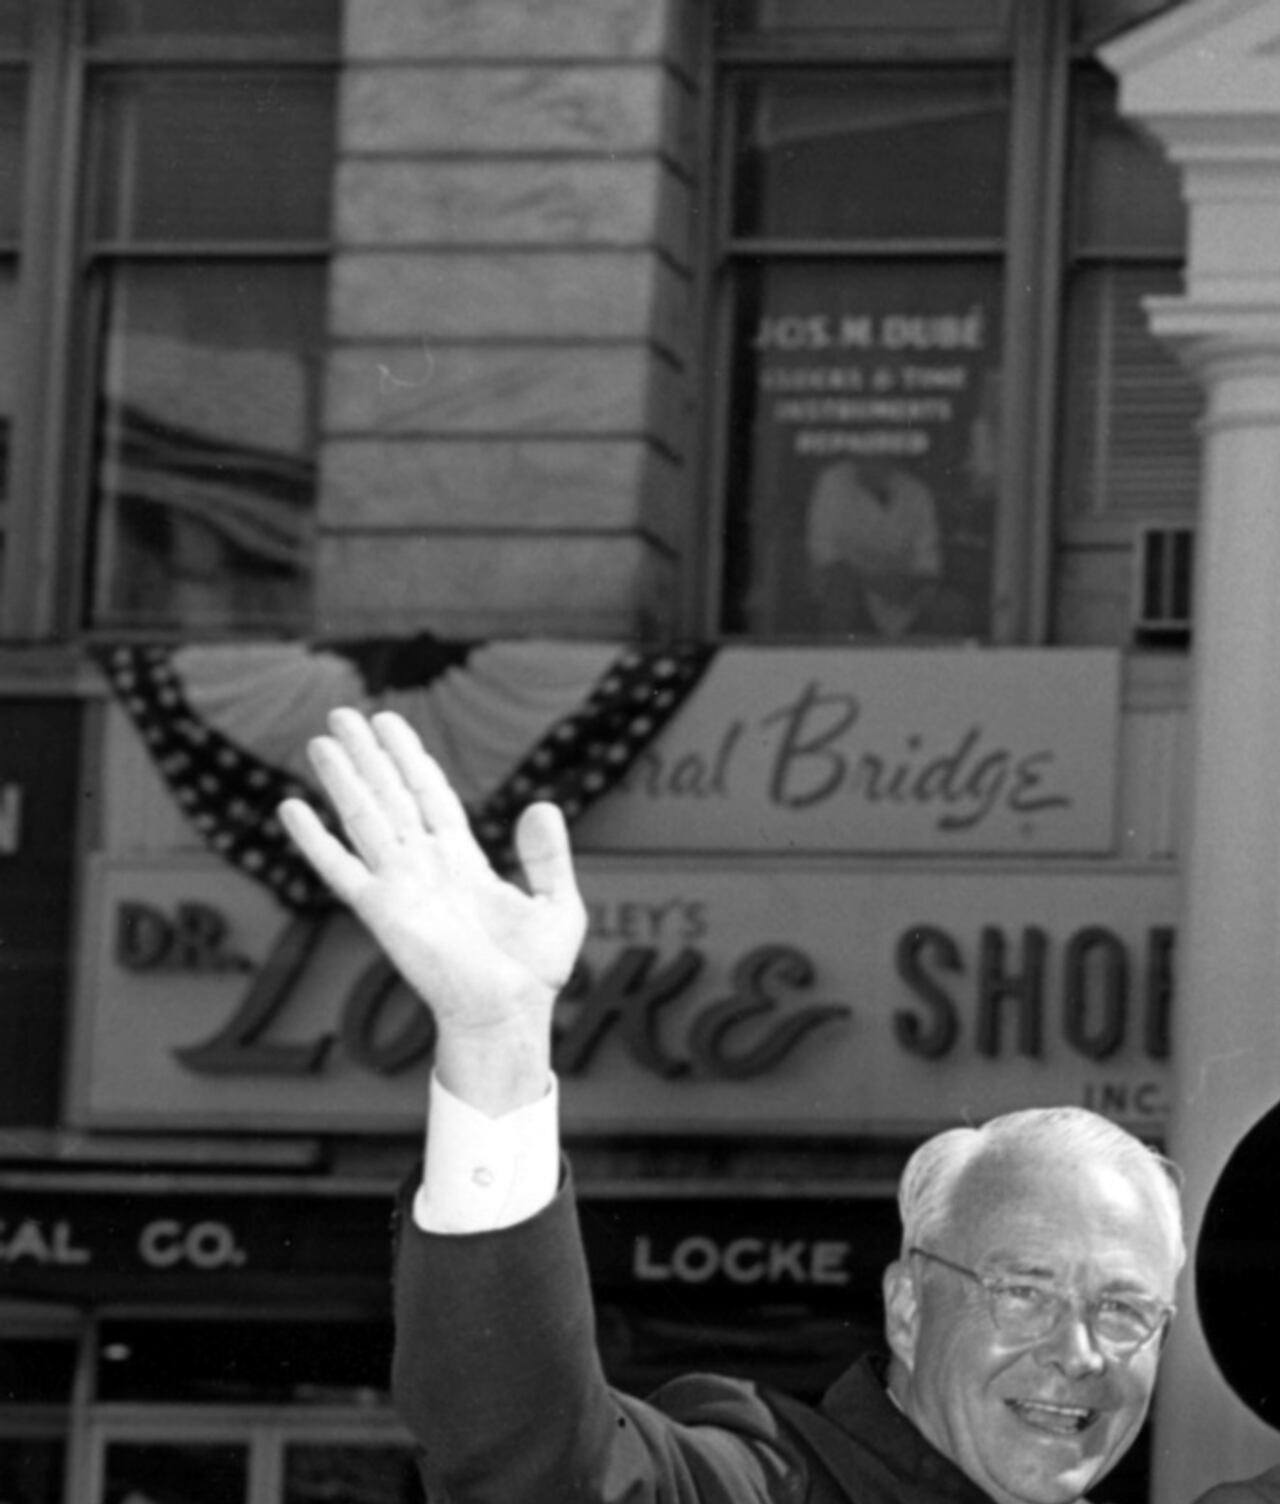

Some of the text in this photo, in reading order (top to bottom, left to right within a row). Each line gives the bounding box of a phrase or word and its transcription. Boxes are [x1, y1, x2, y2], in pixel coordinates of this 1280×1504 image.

[628, 680, 1074, 834] ral Bridge
[0, 1218, 247, 1268] AL CO.
[633, 1235, 850, 1285] LOCKE
